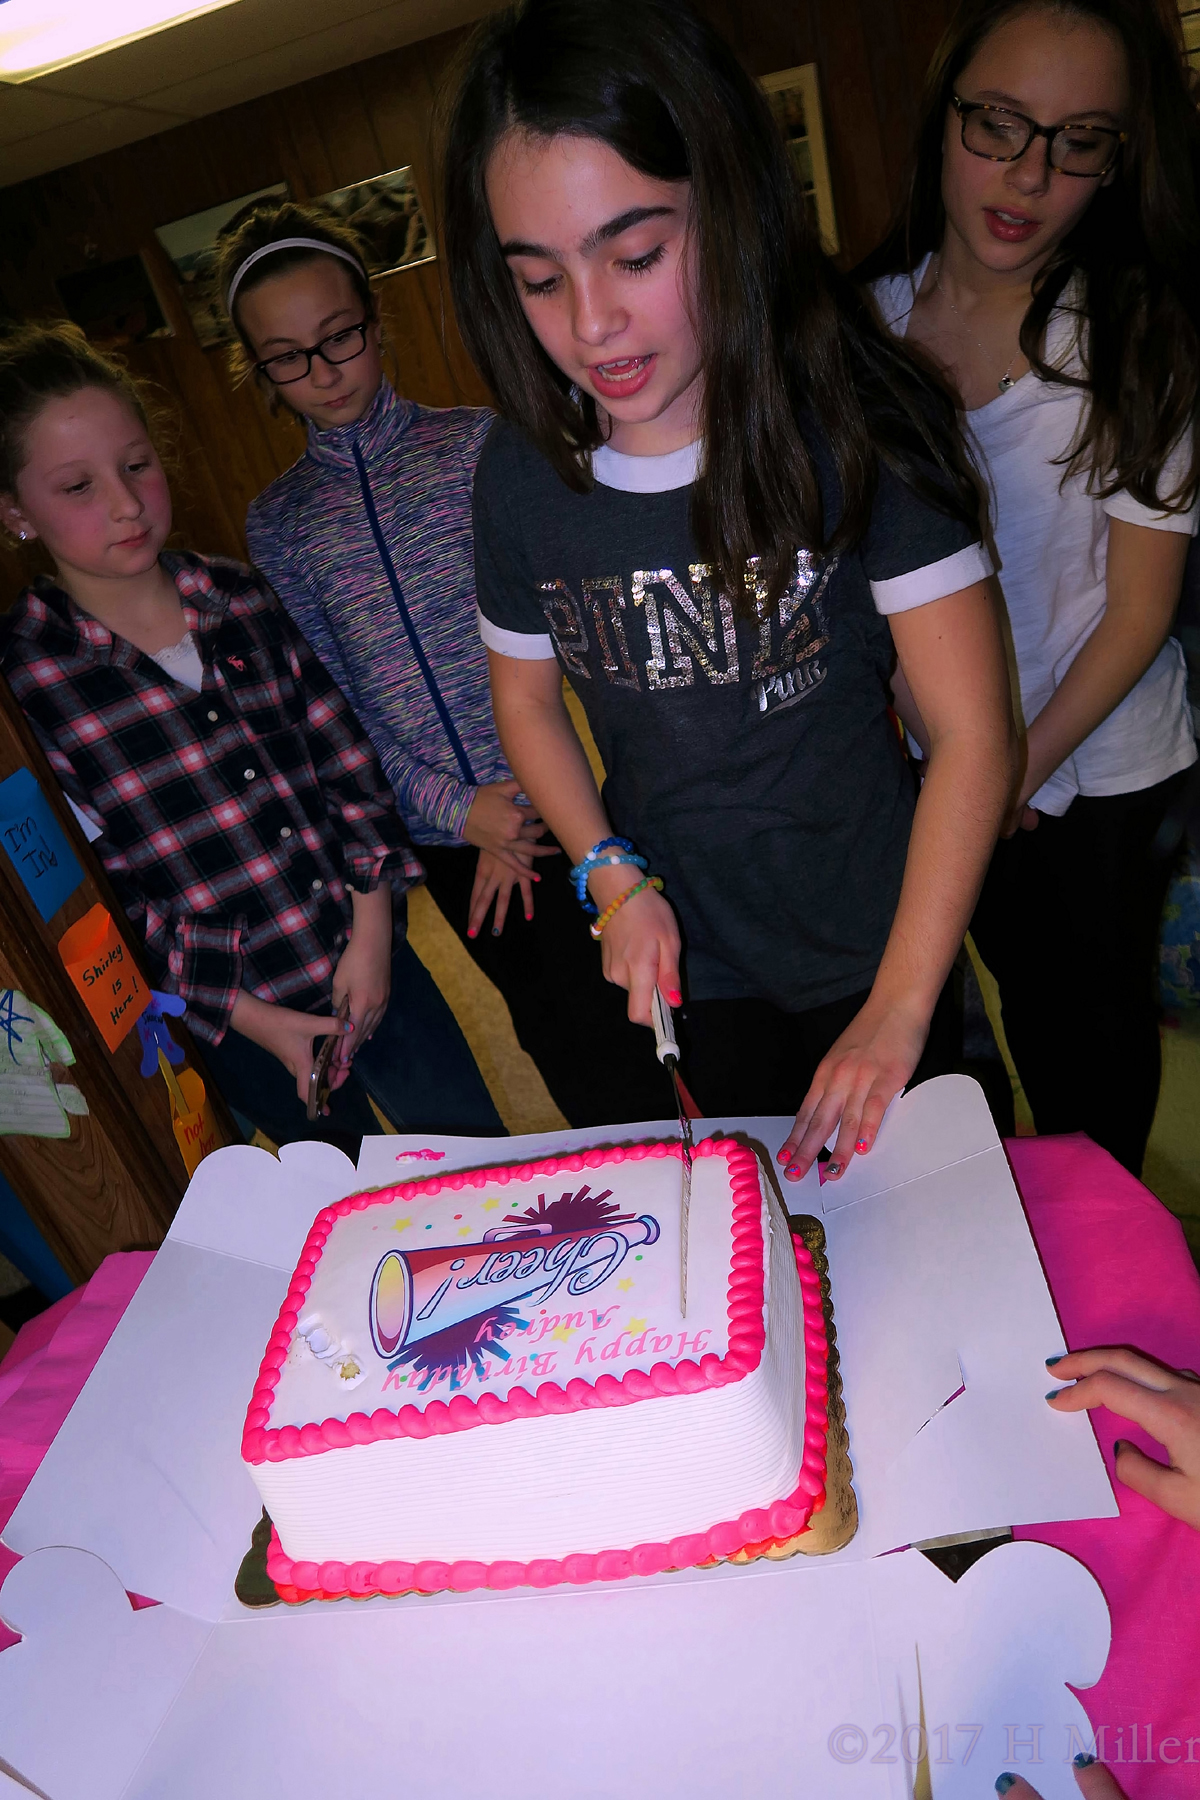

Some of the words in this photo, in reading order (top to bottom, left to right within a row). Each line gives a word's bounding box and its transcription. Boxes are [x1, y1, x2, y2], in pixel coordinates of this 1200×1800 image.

[536, 549, 839, 692] PINK
[82, 944, 124, 988] Shirley
[416, 1231, 629, 1321] Cheer!
[474, 1305, 621, 1345] Audrey
[573, 1328, 713, 1366] Happy
[381, 1350, 559, 1396] Birthday
